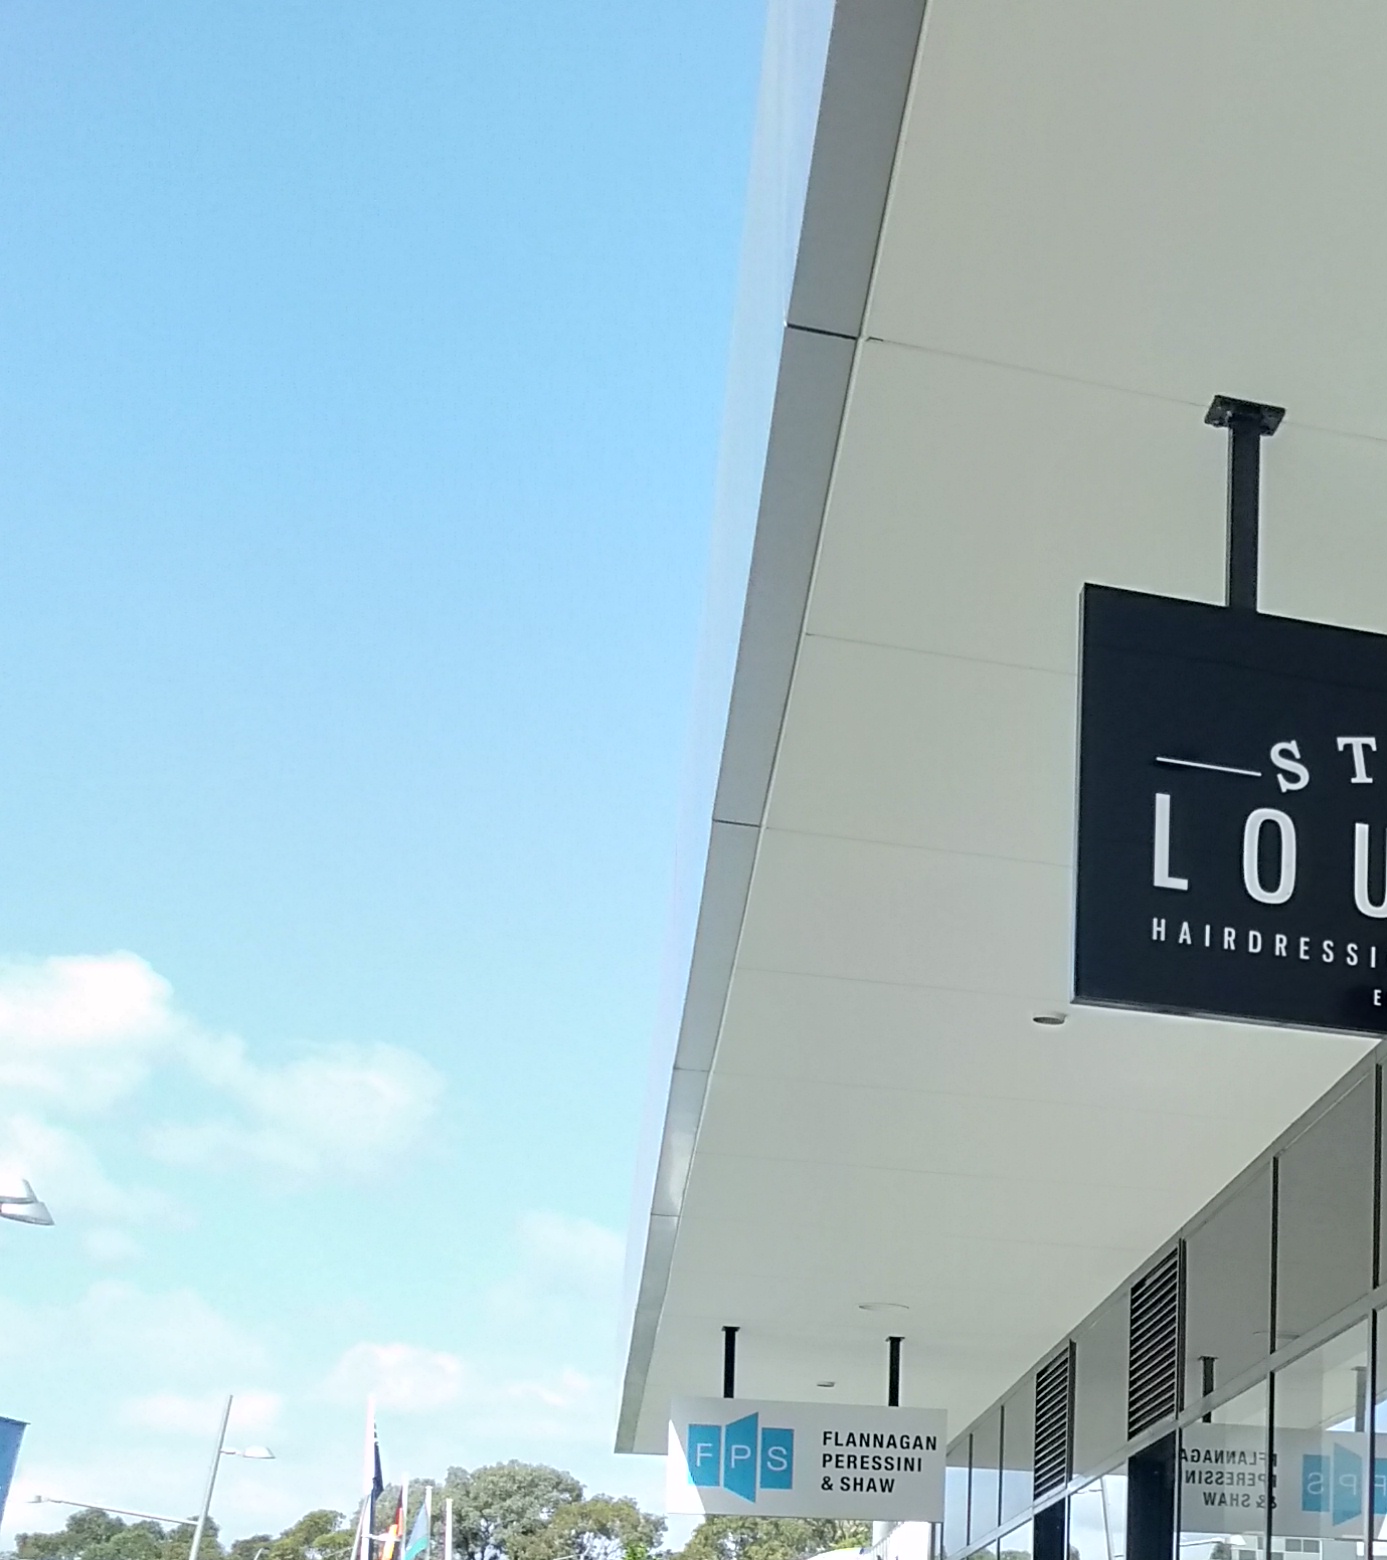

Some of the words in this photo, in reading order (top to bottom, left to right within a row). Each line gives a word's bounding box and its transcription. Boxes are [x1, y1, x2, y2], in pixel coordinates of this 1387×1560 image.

[822, 1430, 938, 1451] FLANNAGAN
[822, 1453, 923, 1473] PERESSINI
[821, 1475, 834, 1492] &
[840, 1475, 896, 1493] SHAW
